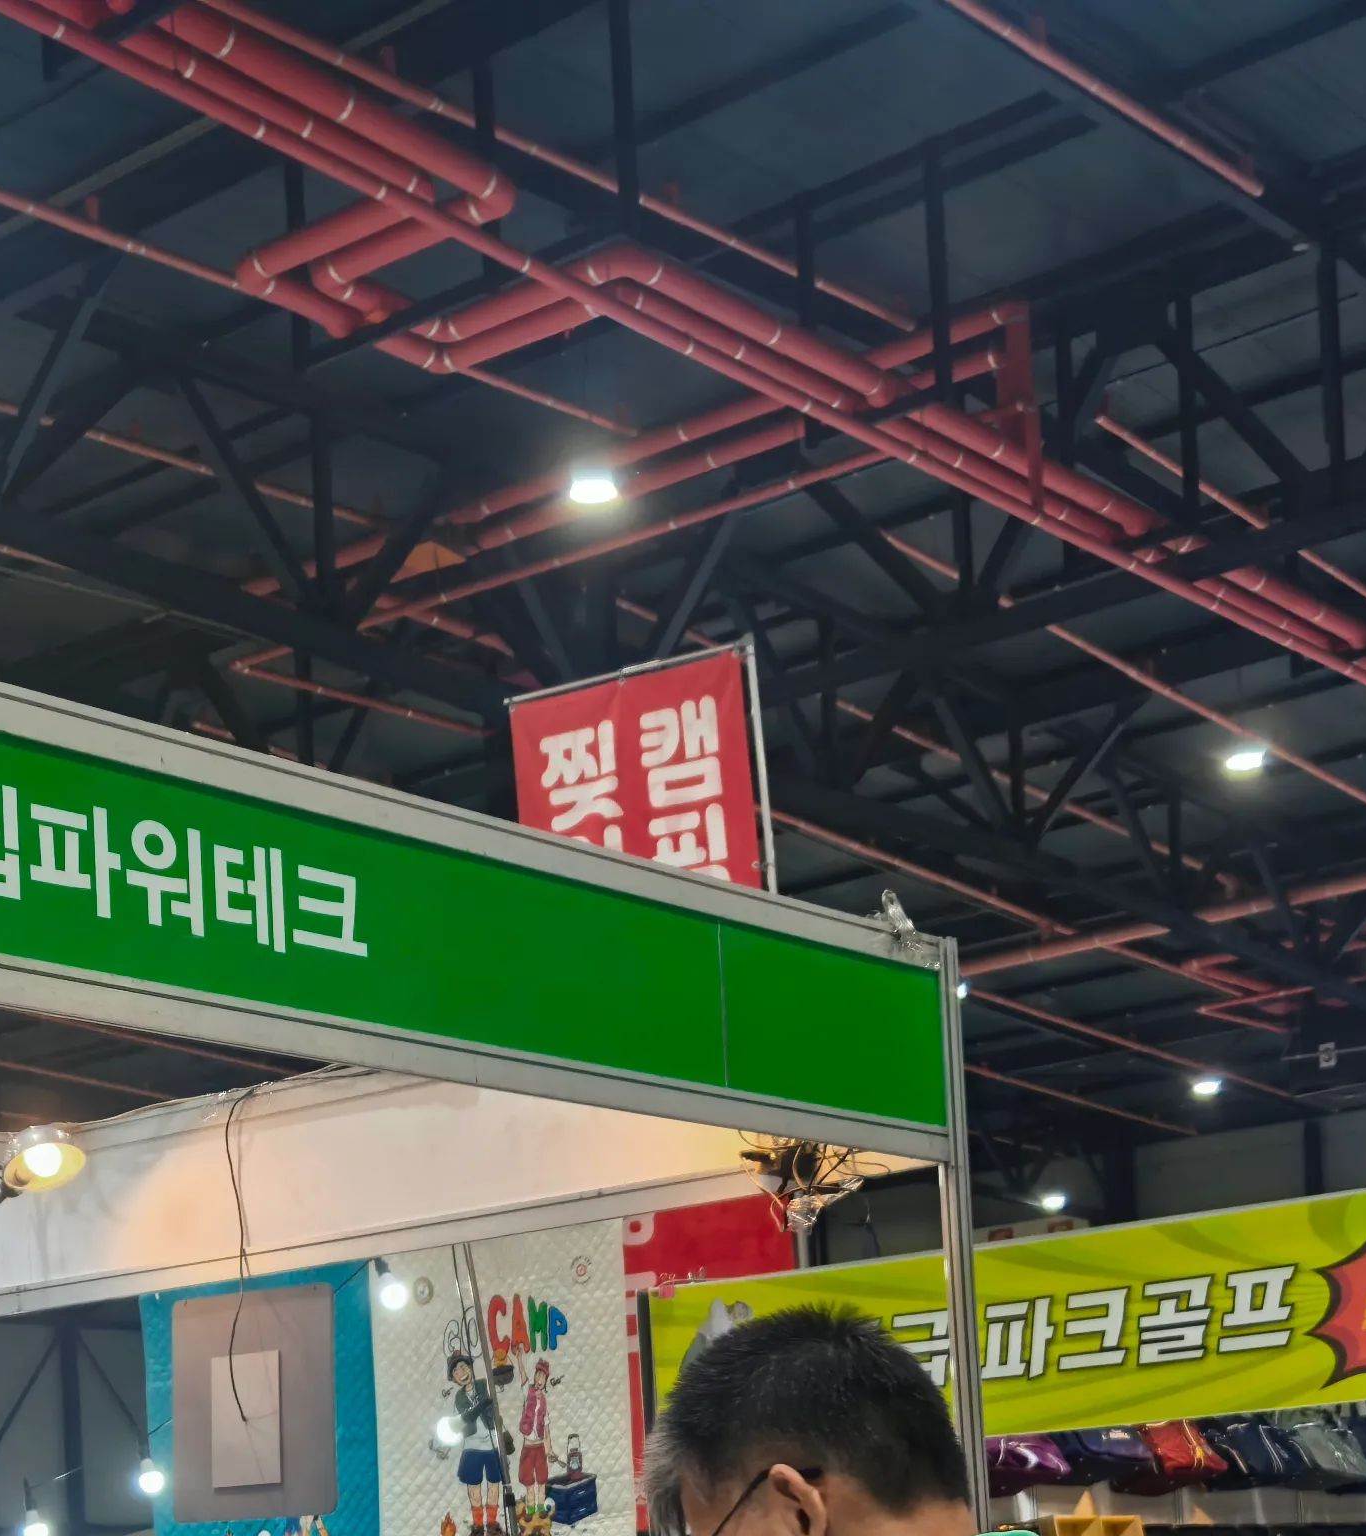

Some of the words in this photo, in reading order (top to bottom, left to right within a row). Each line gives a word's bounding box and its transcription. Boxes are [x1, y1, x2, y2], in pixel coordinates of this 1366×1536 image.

[539, 718, 624, 853] 찢
[487, 1292, 568, 1356] CAMP
[980, 1264, 1297, 1382] 파크골프
